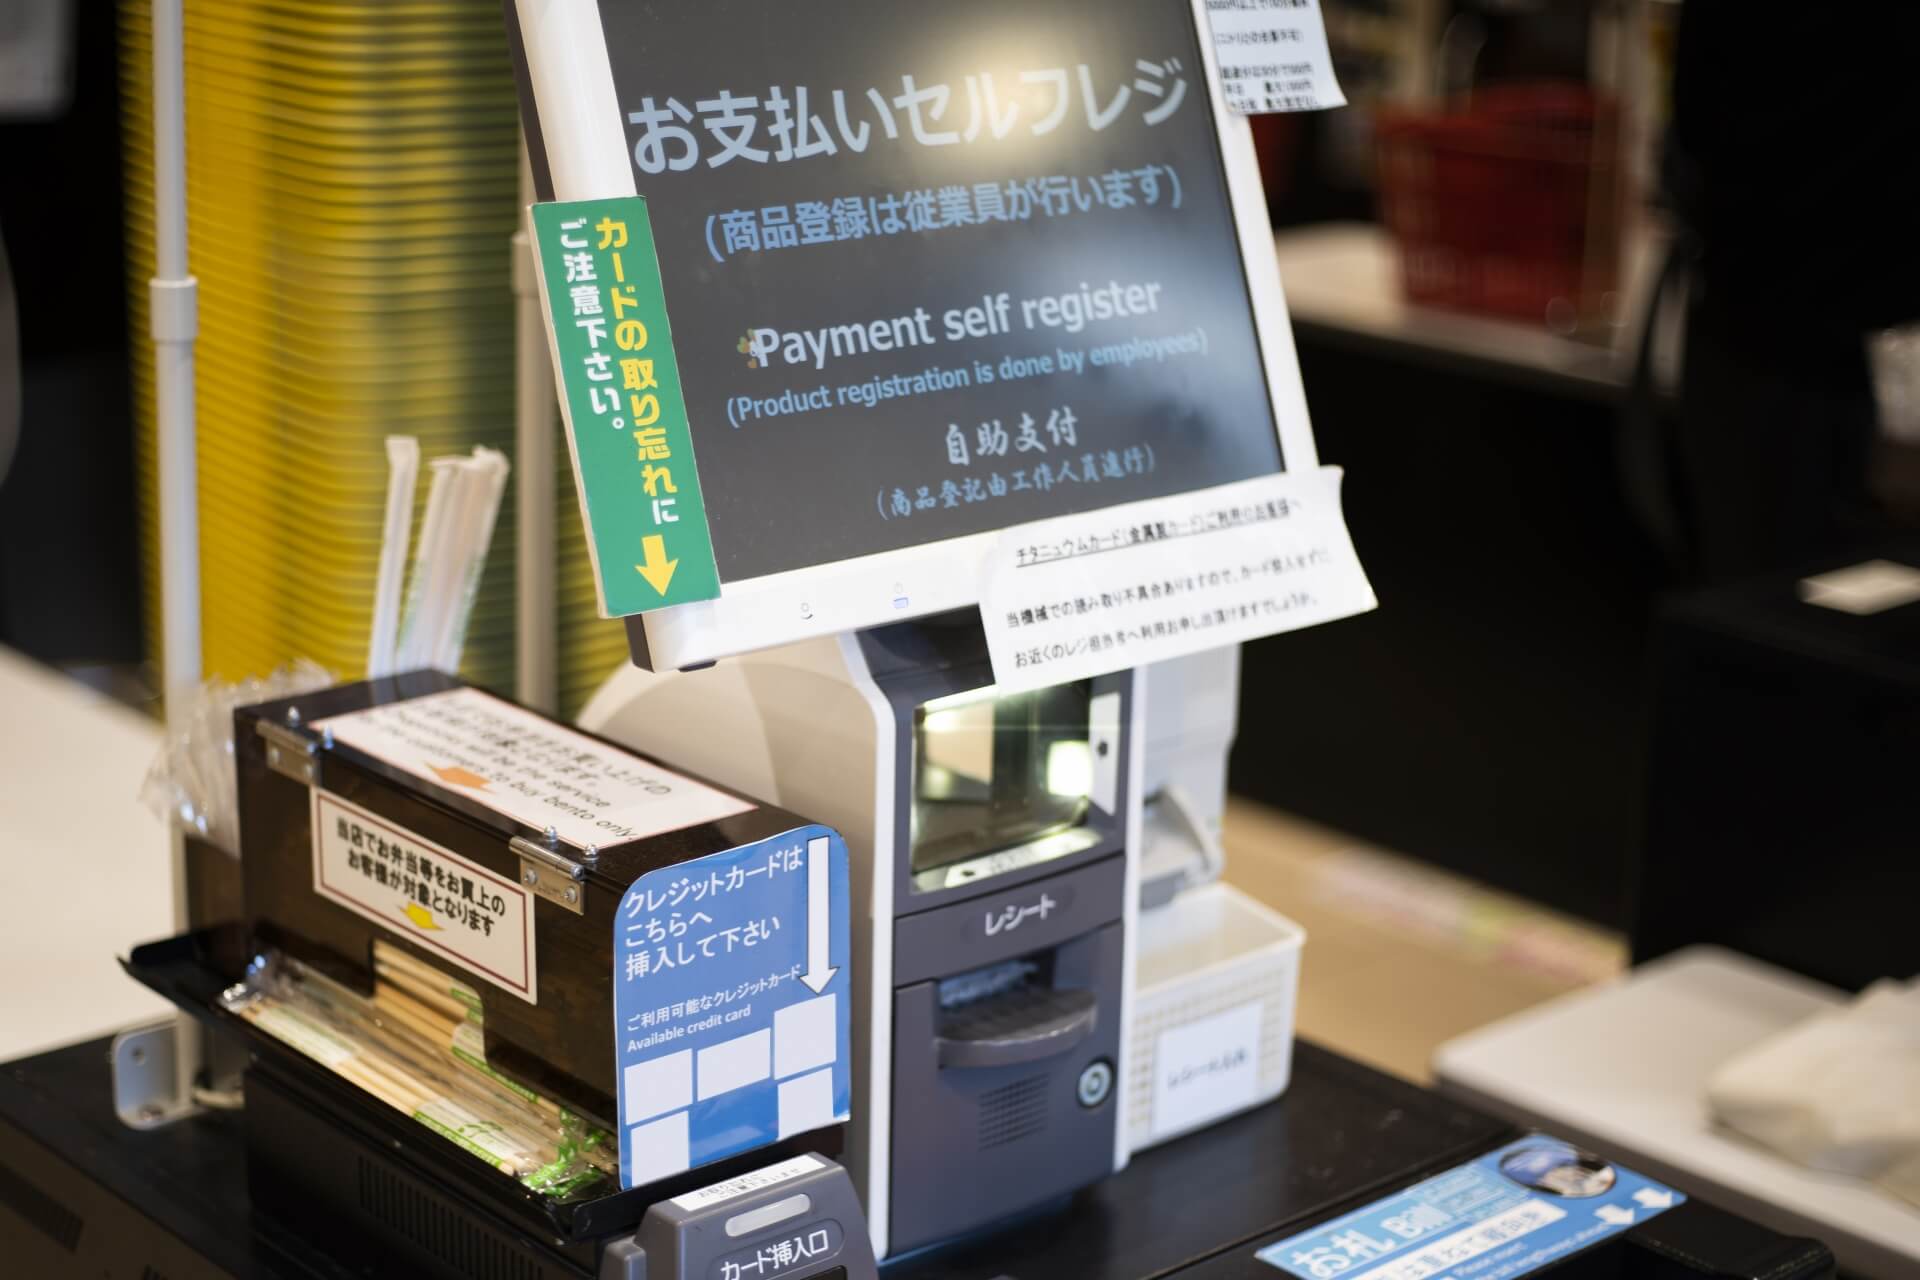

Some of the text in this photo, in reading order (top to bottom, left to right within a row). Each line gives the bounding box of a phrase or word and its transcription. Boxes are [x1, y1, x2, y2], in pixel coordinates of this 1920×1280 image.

[628, 57, 1187, 174] お支払いセルフレジ
[705, 164, 1181, 262] (商品登録は従業員が行います)
[560, 217, 625, 430] ご注意下さい。
[752, 279, 1161, 370] Payment self register
[595, 217, 680, 525] カードの取り忘れに
[727, 327, 1209, 429] (Product registration is done by employees)
[944, 405, 1080, 467] 自助支付
[544, 795, 595, 821] bento
[596, 819, 637, 841] only.
[547, 780, 611, 807] service
[625, 844, 804, 918] クレジットカードは
[625, 911, 713, 948] こちらへ
[985, 893, 1056, 937] レシート
[625, 916, 781, 982] 挿入して下さい
[627, 963, 801, 1032] ご利用可能なクレジットカード
[627, 1004, 751, 1053] Available credit card
[720, 1229, 829, 1280] カード挿入口
[1290, 1229, 1396, 1279] お札
